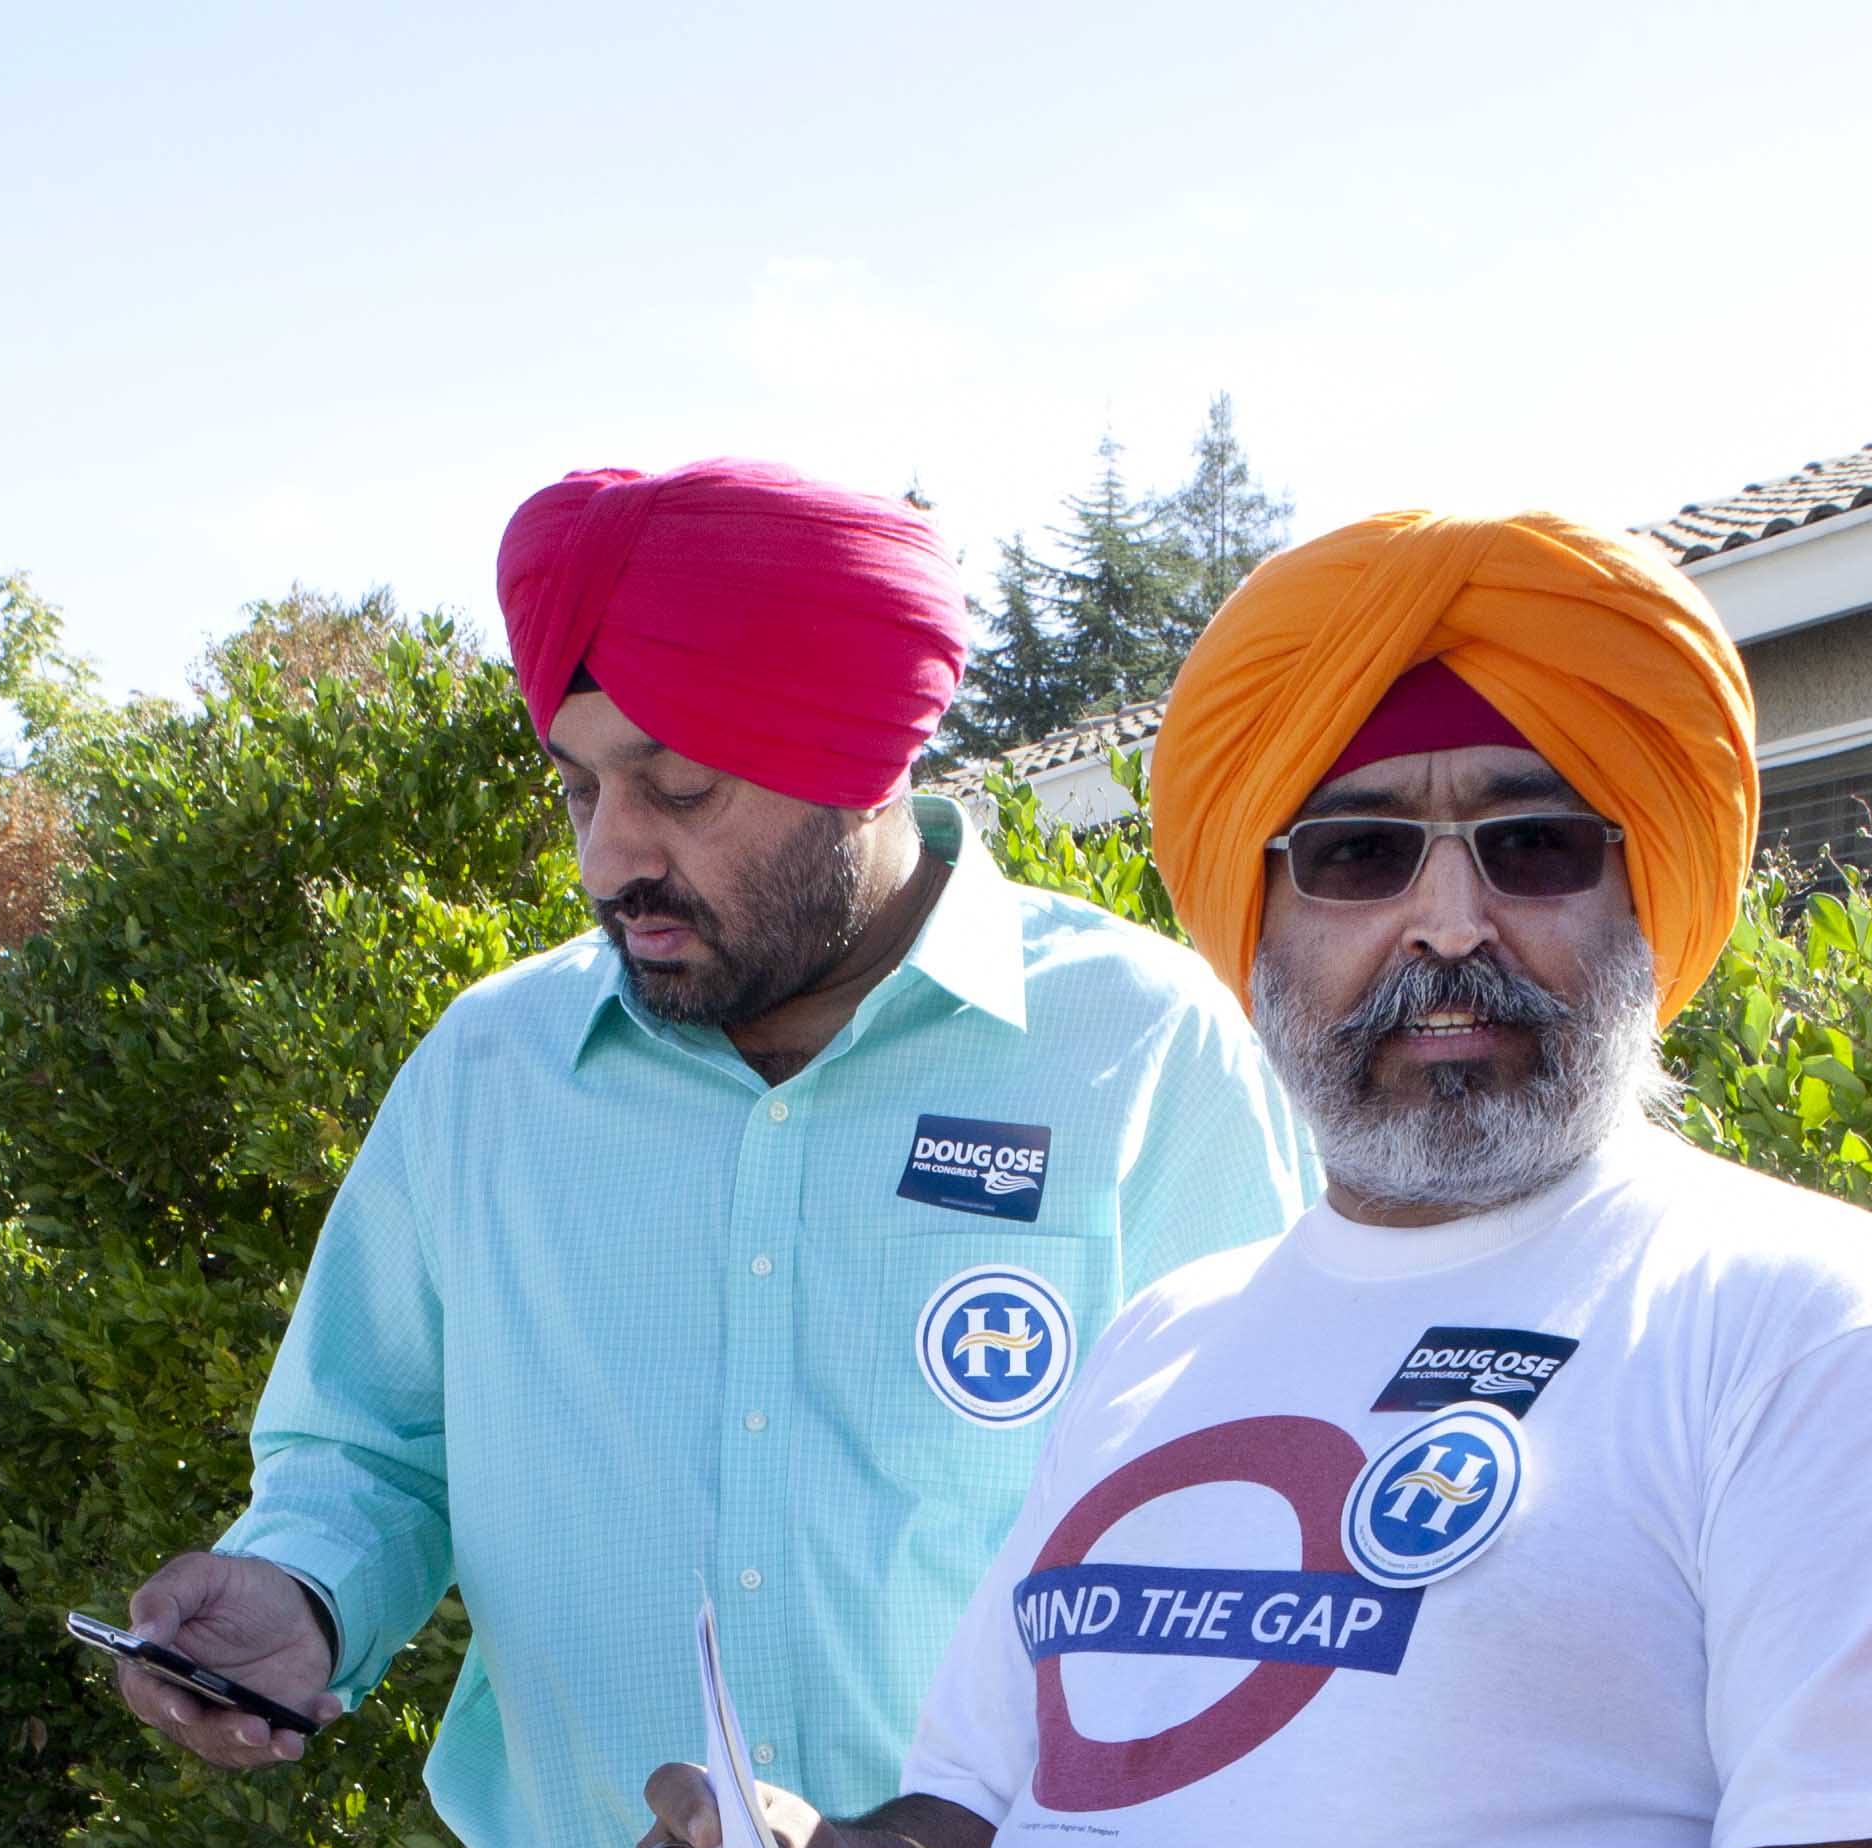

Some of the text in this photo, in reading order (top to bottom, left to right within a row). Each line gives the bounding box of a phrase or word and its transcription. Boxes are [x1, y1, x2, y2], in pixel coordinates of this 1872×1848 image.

[912, 1161, 978, 1178] FOR CONGRESS
[914, 1137, 1045, 1173] DOUG OSE
[1399, 1370, 1470, 1380] FOR CONGRESS
[1406, 1348, 1561, 1379] DOUG OSE
[1016, 1586, 1382, 1652] MIND THE GAP
